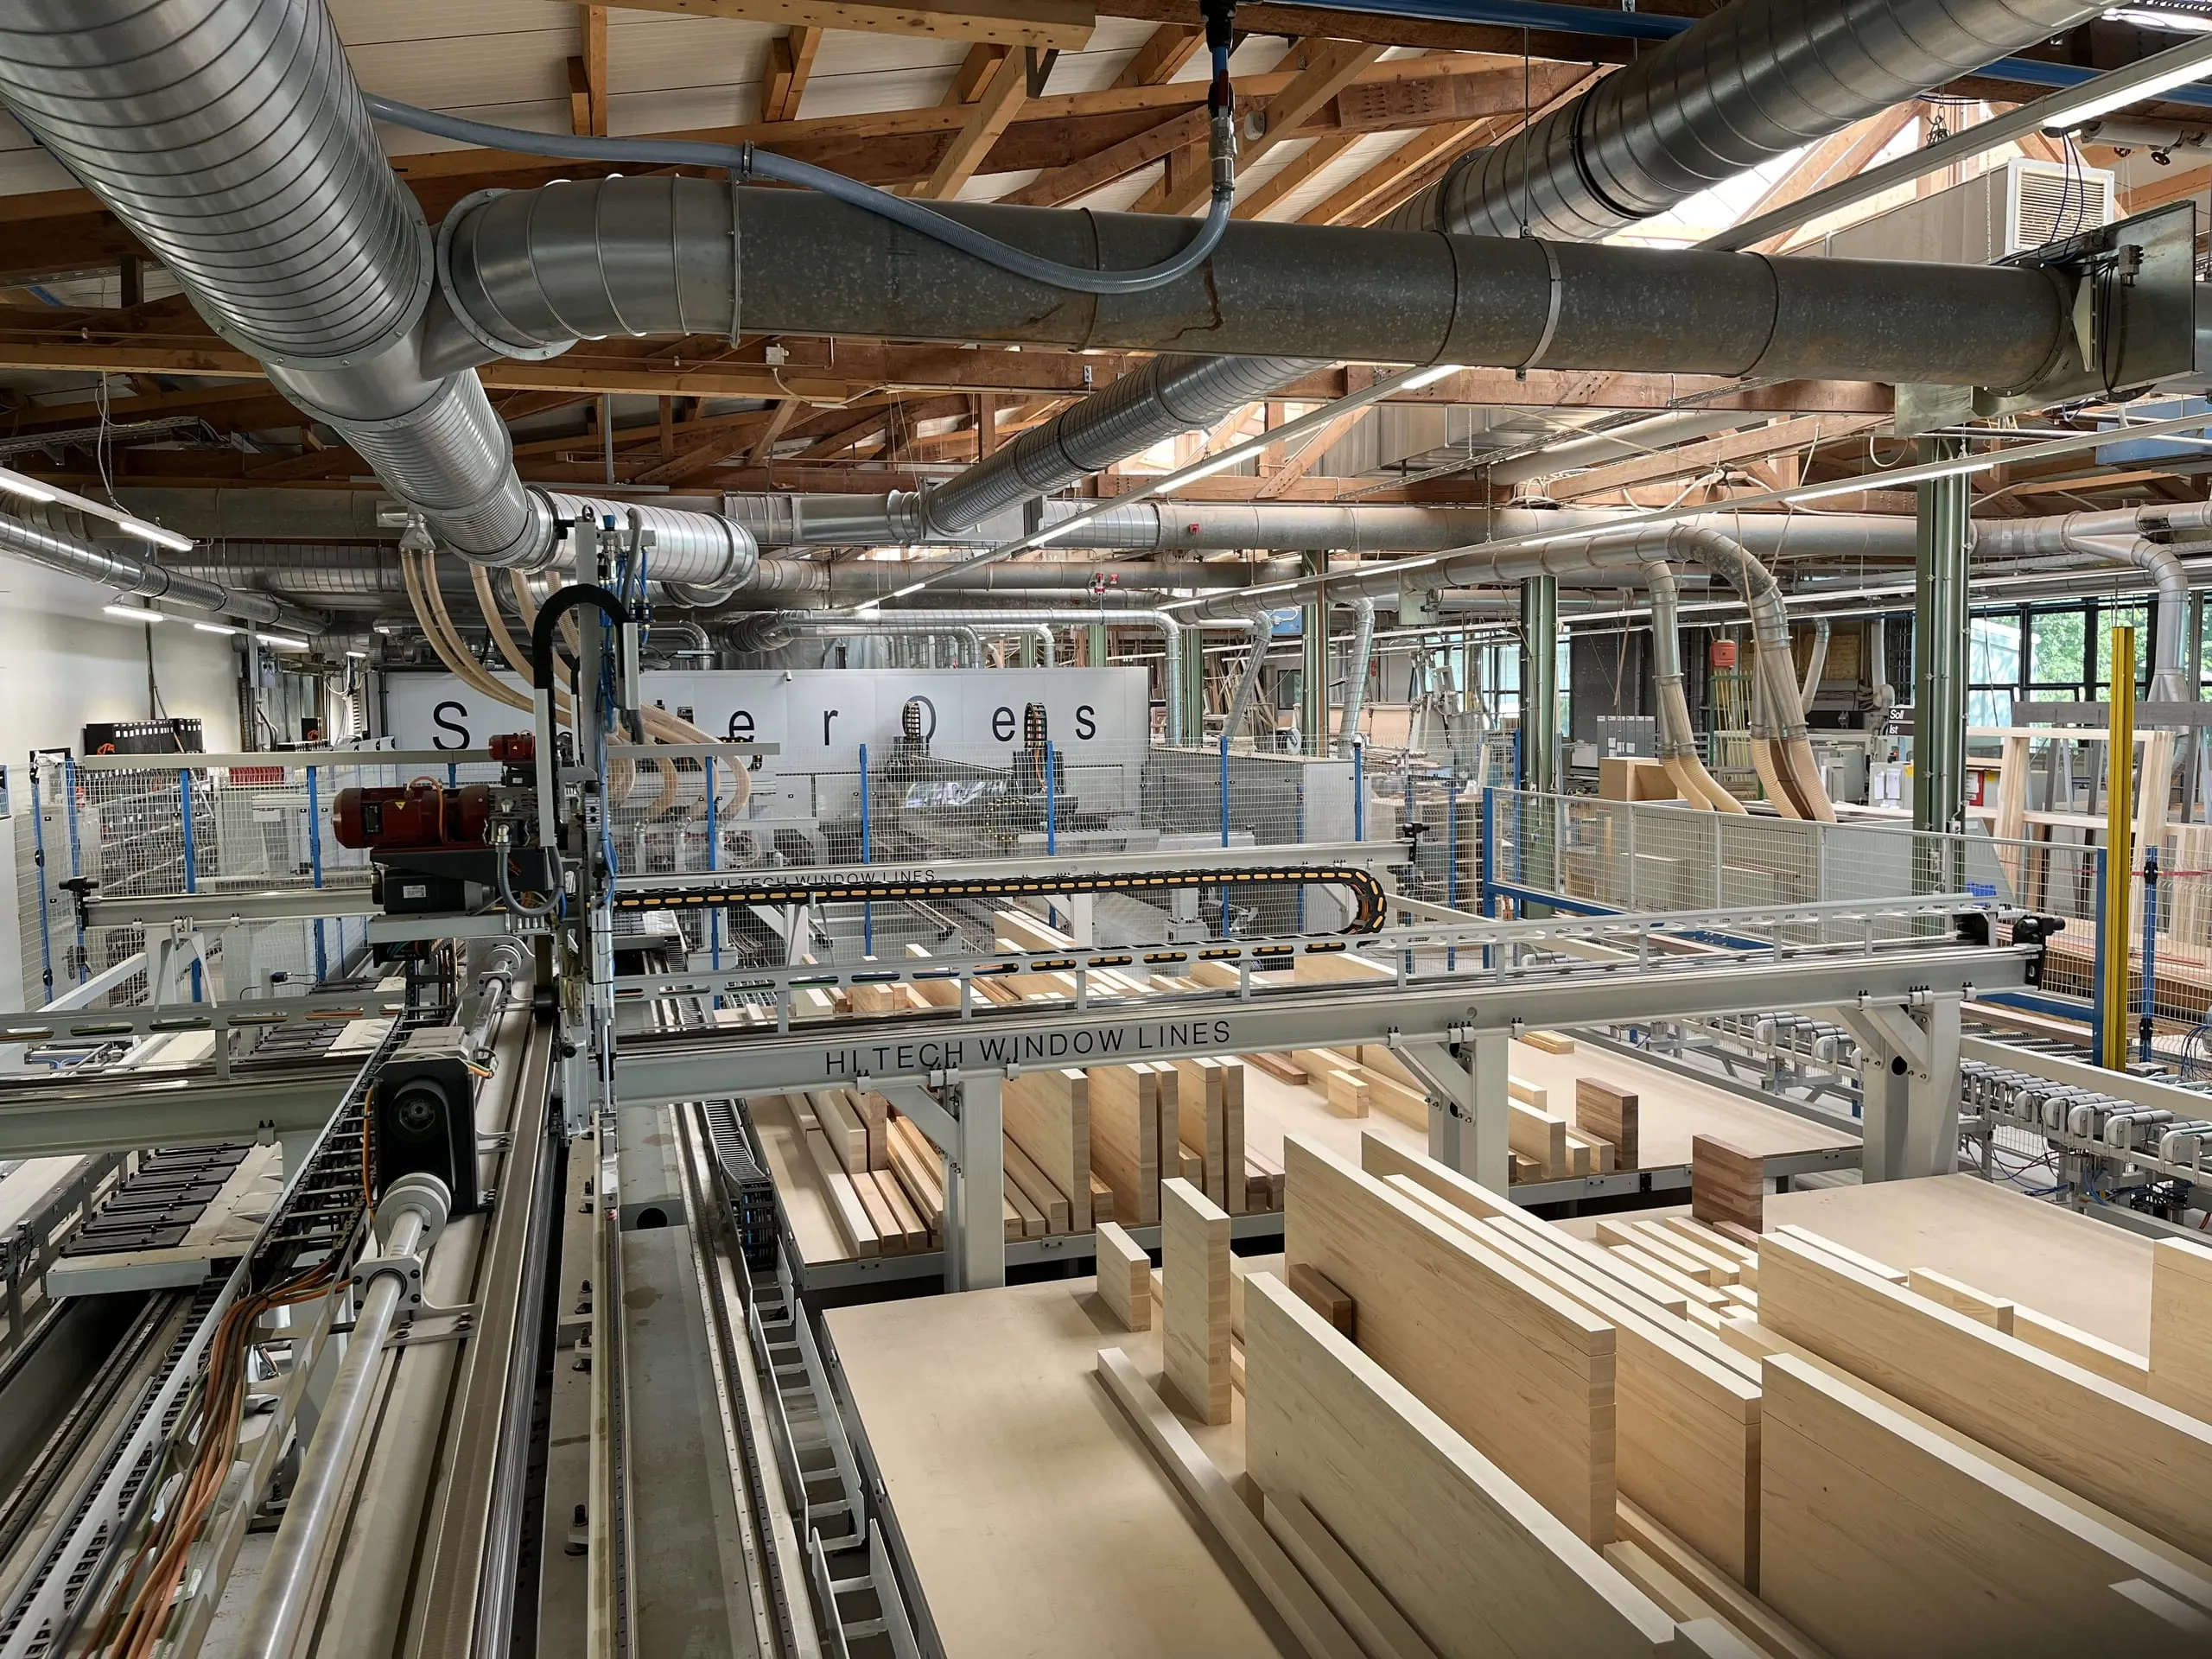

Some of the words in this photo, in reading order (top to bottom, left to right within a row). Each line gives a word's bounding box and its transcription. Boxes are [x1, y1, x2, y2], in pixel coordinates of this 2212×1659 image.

[1890, 709, 1904, 720] Soll
[1889, 723, 1899, 734] Ist
[825, 1049, 857, 1075] HI
[873, 1040, 963, 1070] TECH
[979, 1028, 1124, 1062] WINDOW
[1138, 1020, 1230, 1050] LINES
